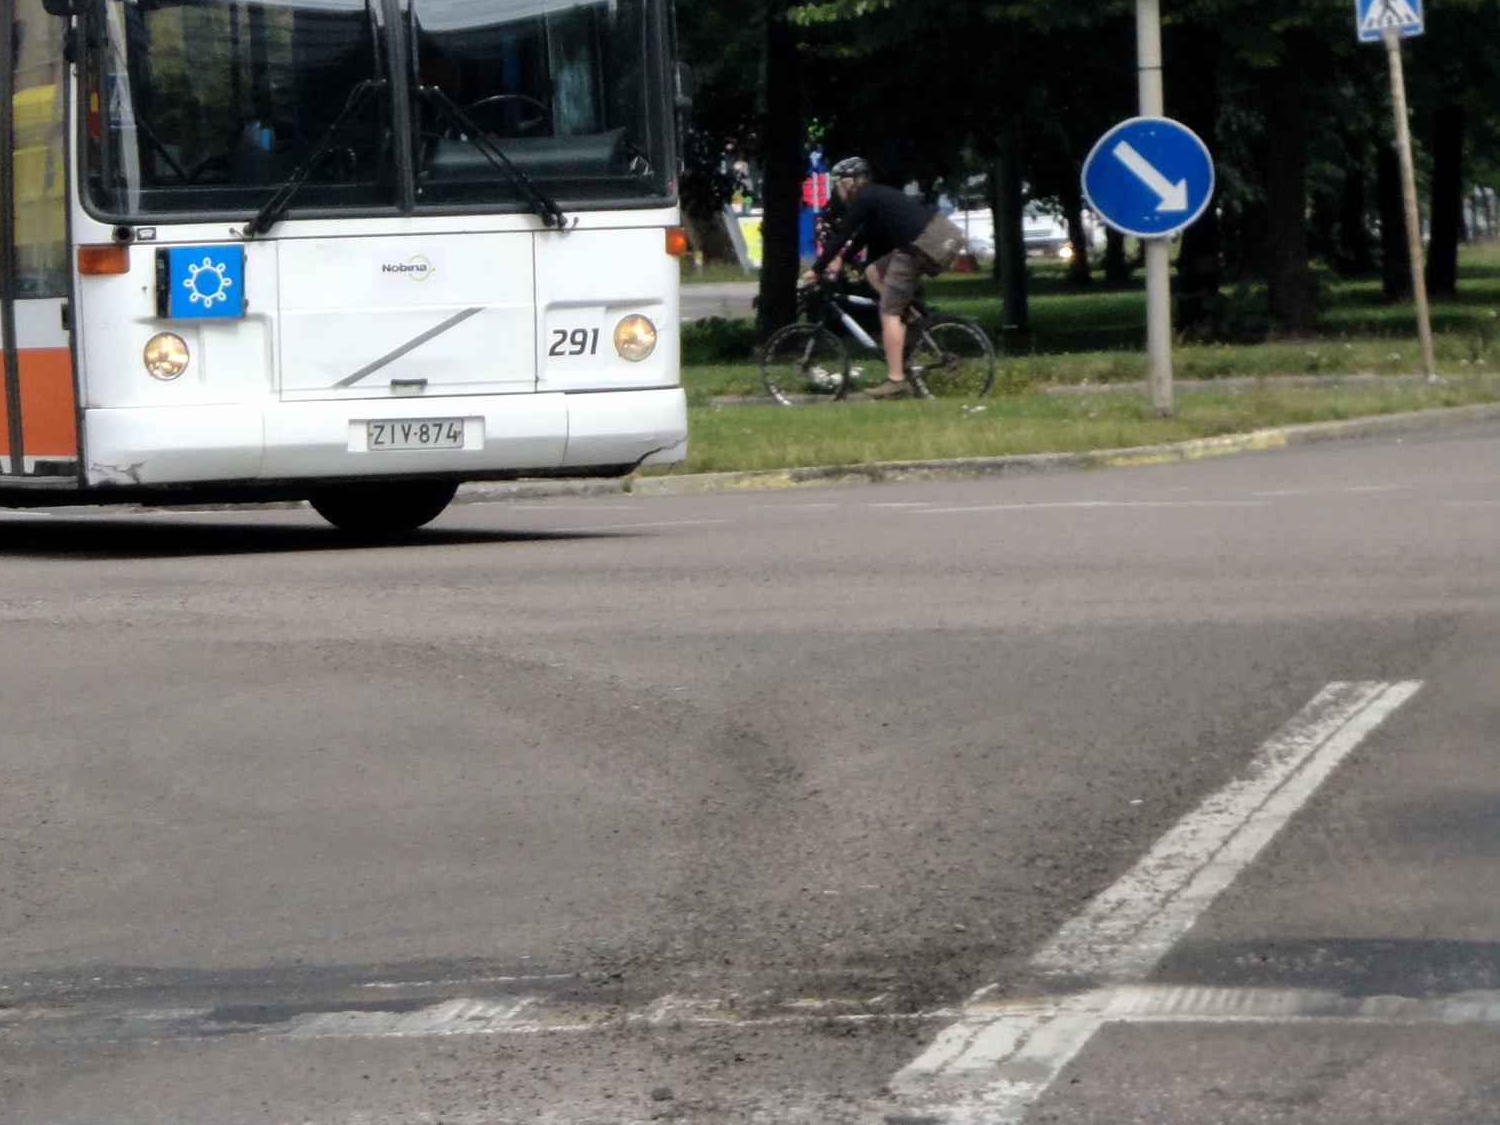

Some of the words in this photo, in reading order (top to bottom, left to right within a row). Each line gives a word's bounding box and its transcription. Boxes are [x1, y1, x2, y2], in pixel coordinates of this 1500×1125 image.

[381, 262, 428, 273] Nobina
[548, 327, 600, 357] 291
[373, 422, 459, 445] ZIV-874
